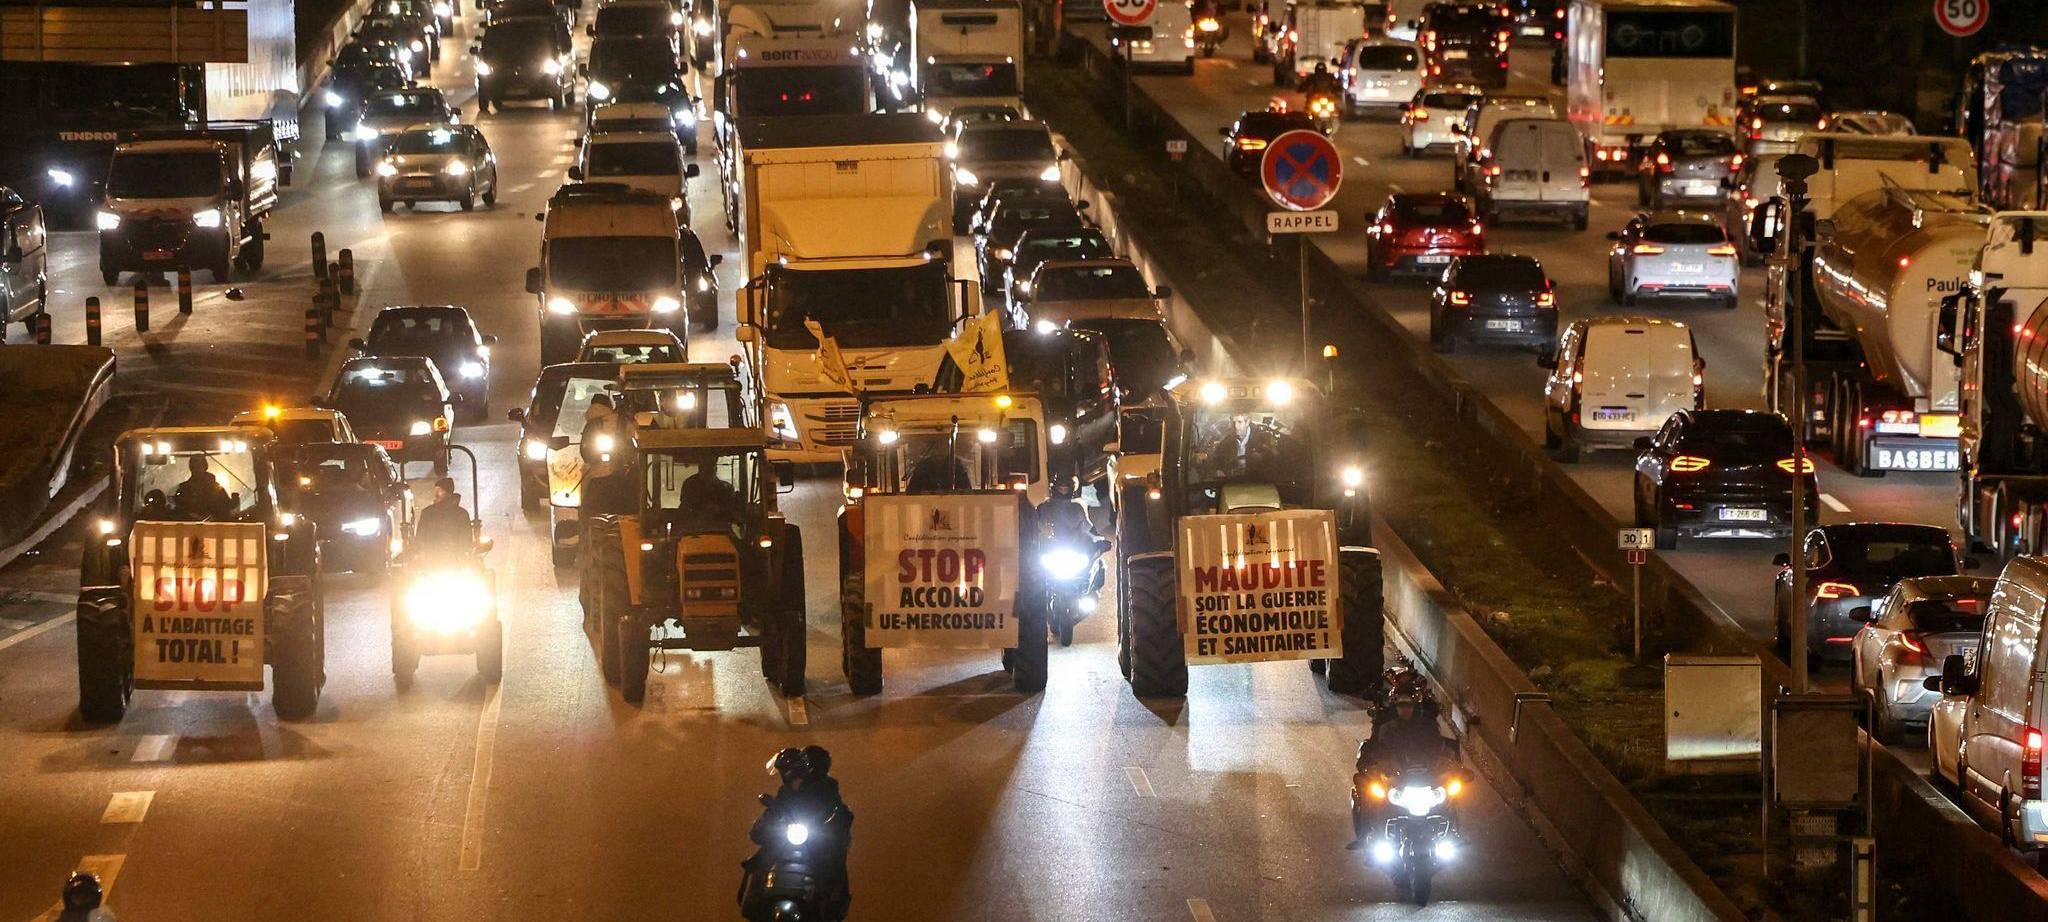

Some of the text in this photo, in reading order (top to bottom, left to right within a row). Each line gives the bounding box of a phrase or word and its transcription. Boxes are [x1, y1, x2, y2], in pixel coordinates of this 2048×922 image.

[1948, 0, 1976, 19] 50
[1274, 216, 1332, 228] RAPPEL
[1879, 450, 1959, 469] BASBEN
[898, 548, 986, 583] STOP
[1194, 560, 1326, 593] MAUDITE
[154, 576, 245, 612] STOP
[900, 586, 985, 609] ACCORD
[1195, 590, 1327, 612] SOIT LA GUERRE
[160, 617, 254, 635] L'ABATTAGE
[879, 613, 996, 630] UE-MERCOSUR
[1196, 610, 1328, 635] ÉCONOMIQUE
[156, 638, 226, 664] TOTAL
[1198, 637, 1217, 656] ET
[1224, 632, 1316, 655] SANITAIRE
